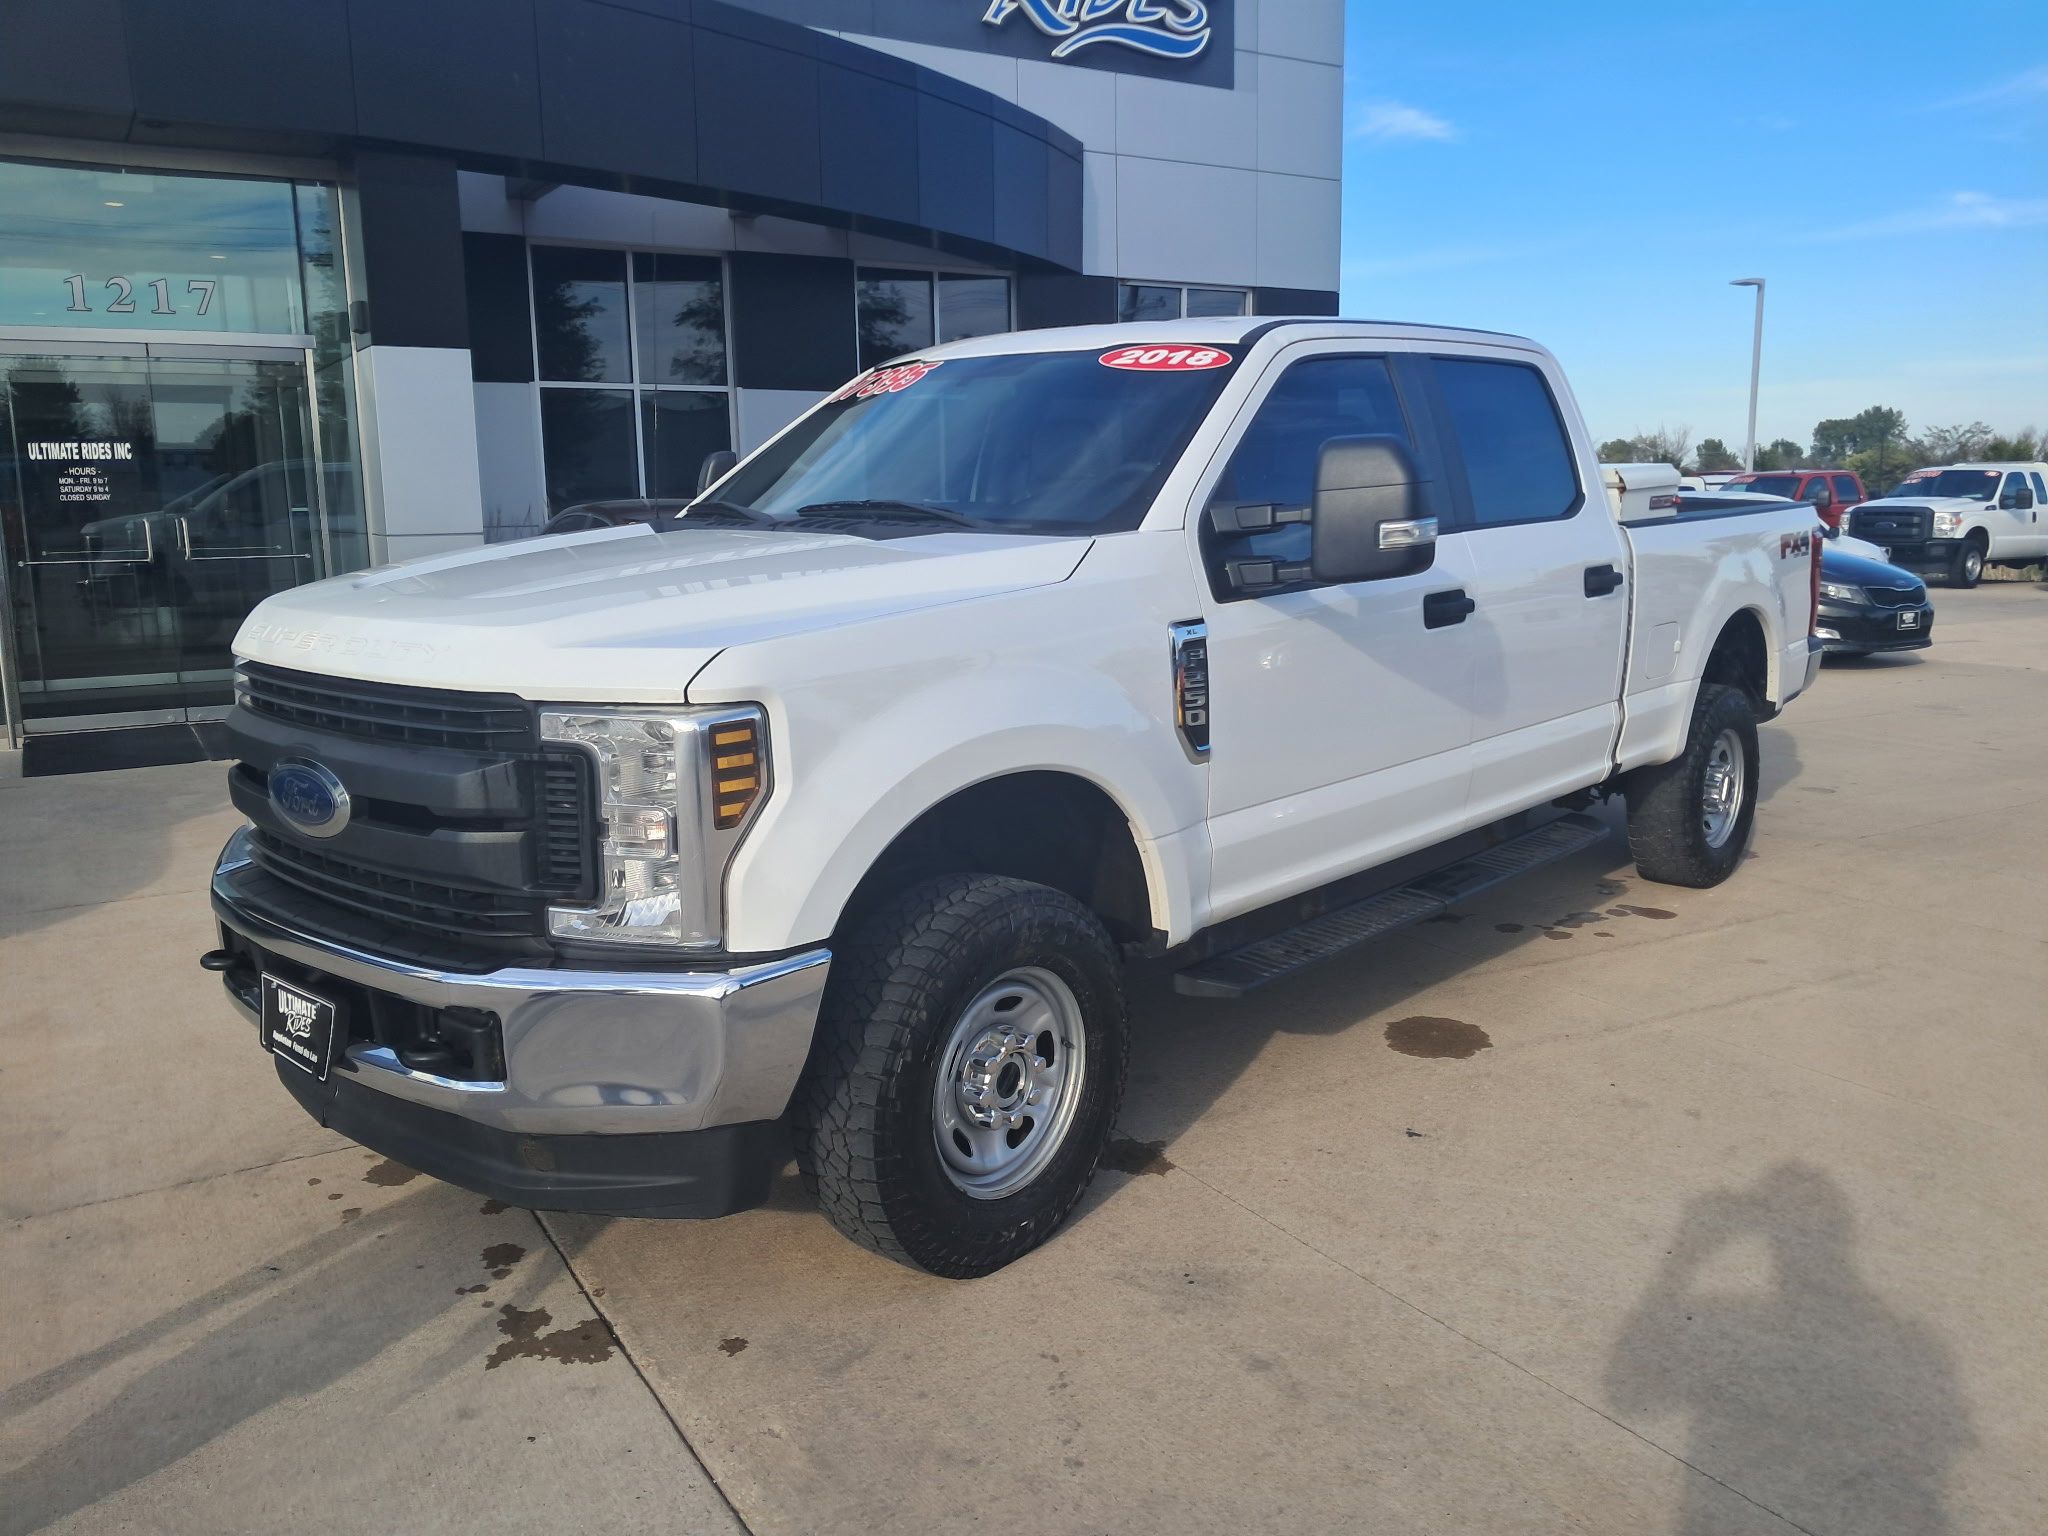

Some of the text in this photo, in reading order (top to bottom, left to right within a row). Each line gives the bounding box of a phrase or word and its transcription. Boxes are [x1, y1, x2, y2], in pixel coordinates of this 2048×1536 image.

[63, 274, 216, 316] 1217
[1109, 349, 1219, 366] 2018
[27, 442, 133, 460] ULTIMATE RIDES INC
[69, 467, 96, 475] HOURS
[1780, 530, 1810, 559] FX4
[248, 623, 453, 664] SUPER DUTY
[1186, 628, 1198, 636] XL
[282, 776, 321, 817] Ford
[278, 988, 317, 1020] ULTIMATE
[285, 1010, 313, 1034] RIDES
